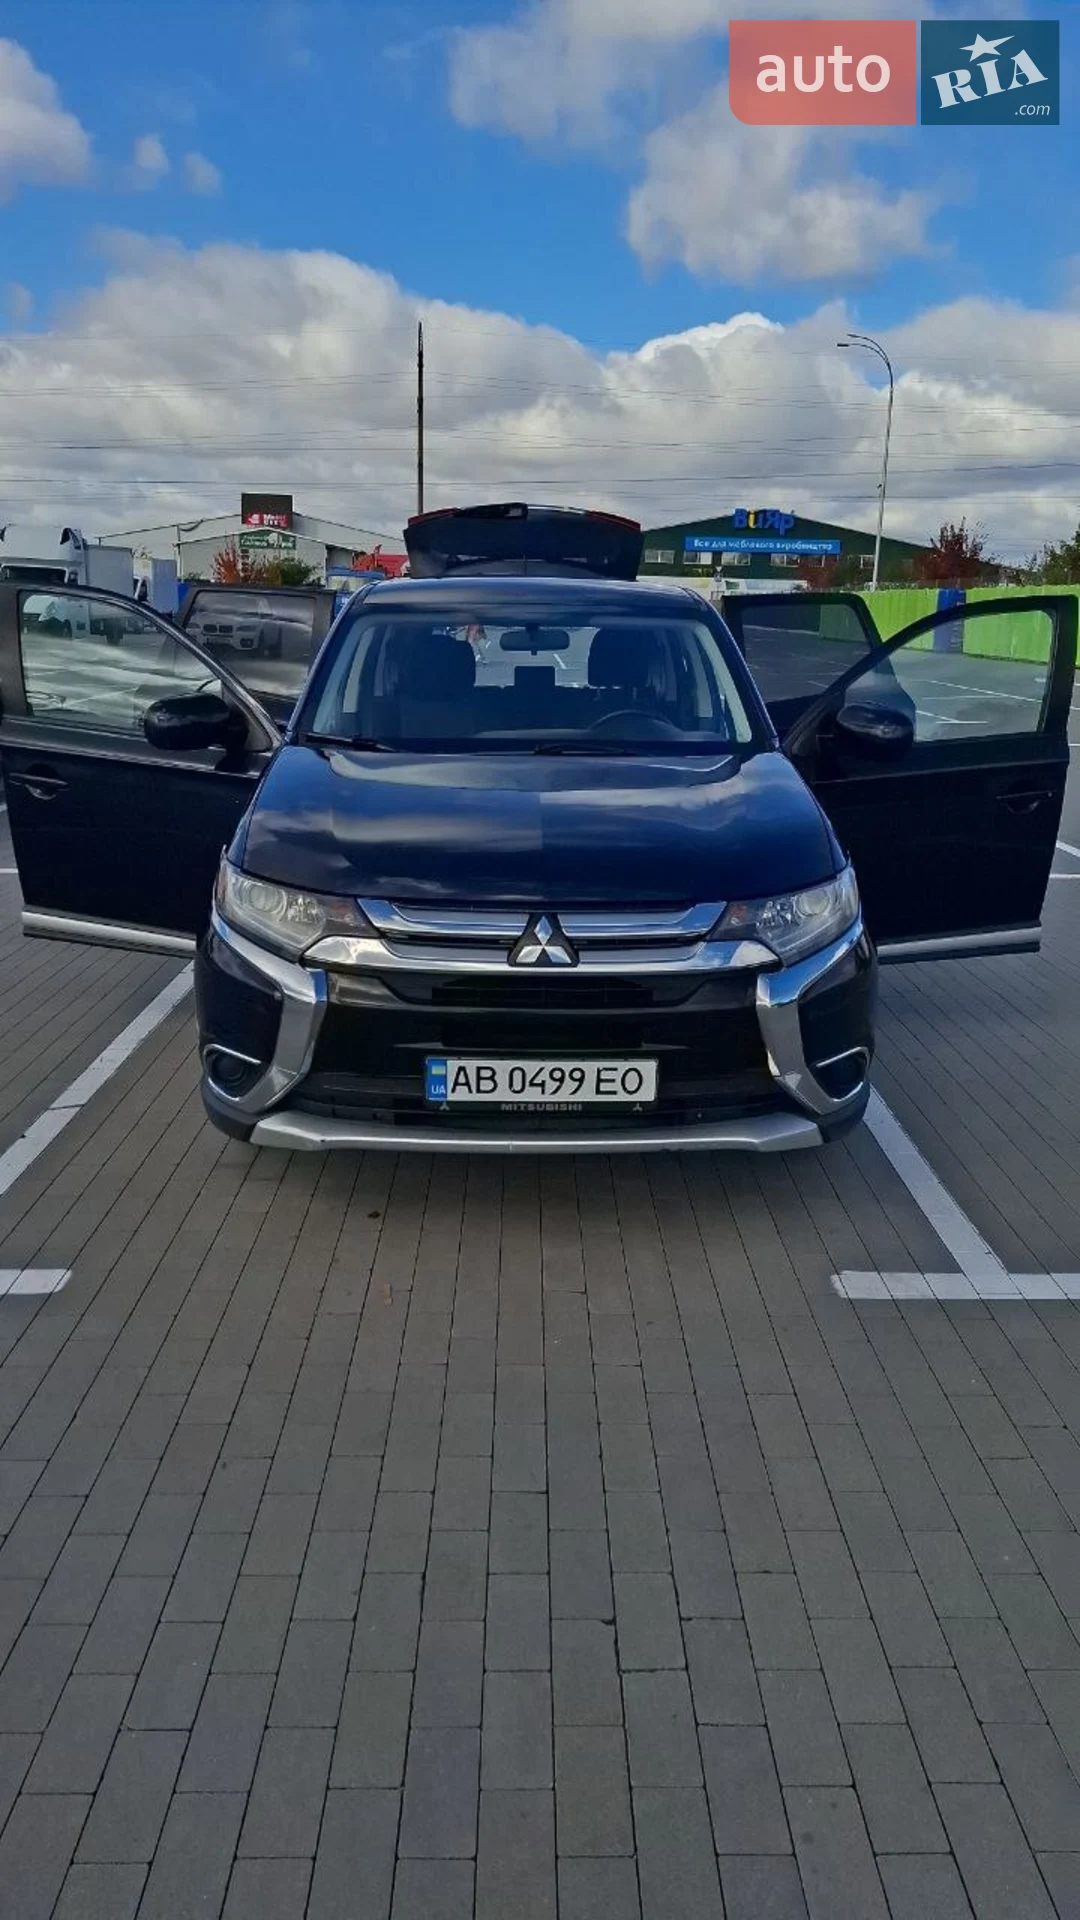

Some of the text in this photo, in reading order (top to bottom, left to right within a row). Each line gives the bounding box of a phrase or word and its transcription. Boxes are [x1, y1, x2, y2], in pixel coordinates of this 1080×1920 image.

[451, 1066, 643, 1096] AB 0499 EO
[431, 1085, 446, 1094] UA
[501, 1103, 583, 1111] MITSUBISHI
